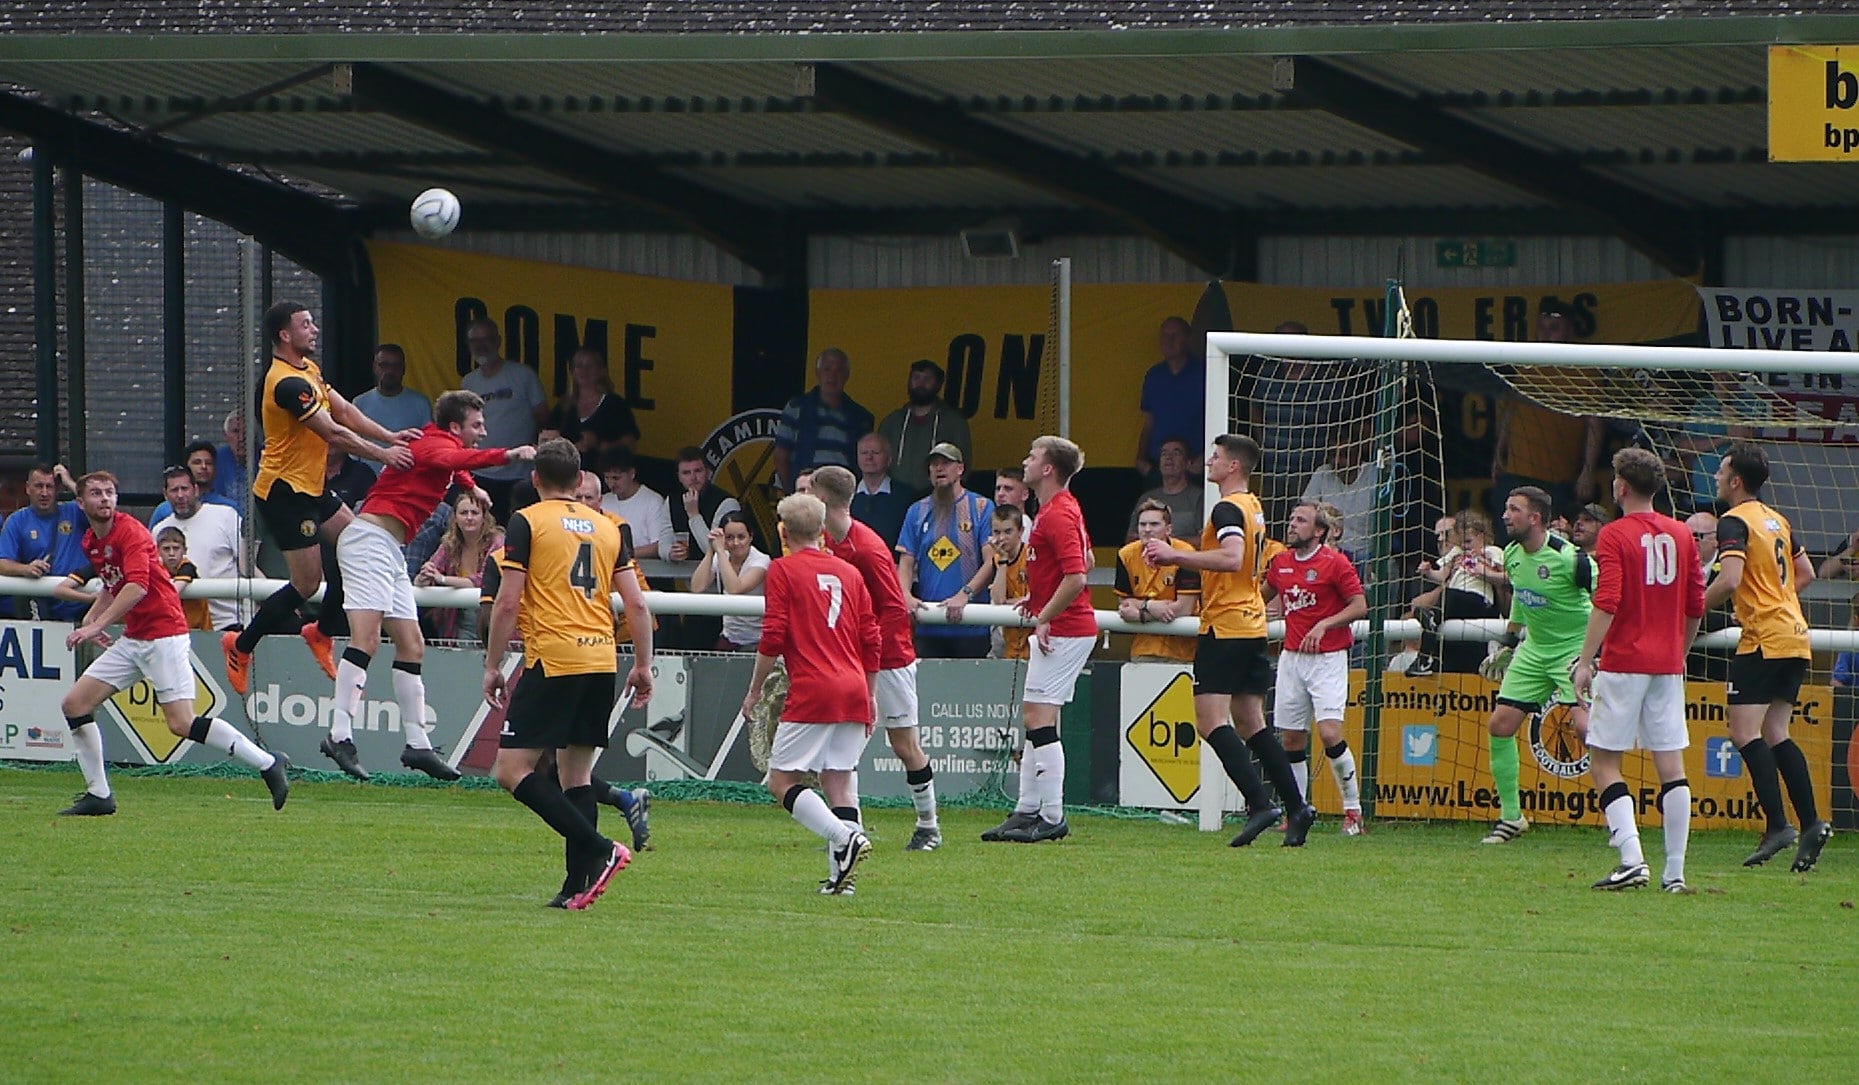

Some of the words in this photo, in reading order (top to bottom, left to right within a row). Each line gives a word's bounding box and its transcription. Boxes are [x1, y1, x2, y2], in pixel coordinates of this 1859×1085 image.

[1715, 295, 1852, 326] BORN-
[455, 297, 656, 410] COME
[944, 333, 1045, 420] ON
[1721, 325, 1814, 351] LIVE
[562, 517, 593, 533] NHS
[570, 542, 598, 600] 4
[1640, 532, 1677, 586] 10
[816, 573, 843, 630] 7
[931, 702, 963, 719] CALL
[965, 703, 984, 719] US
[987, 704, 1021, 720] NOW
